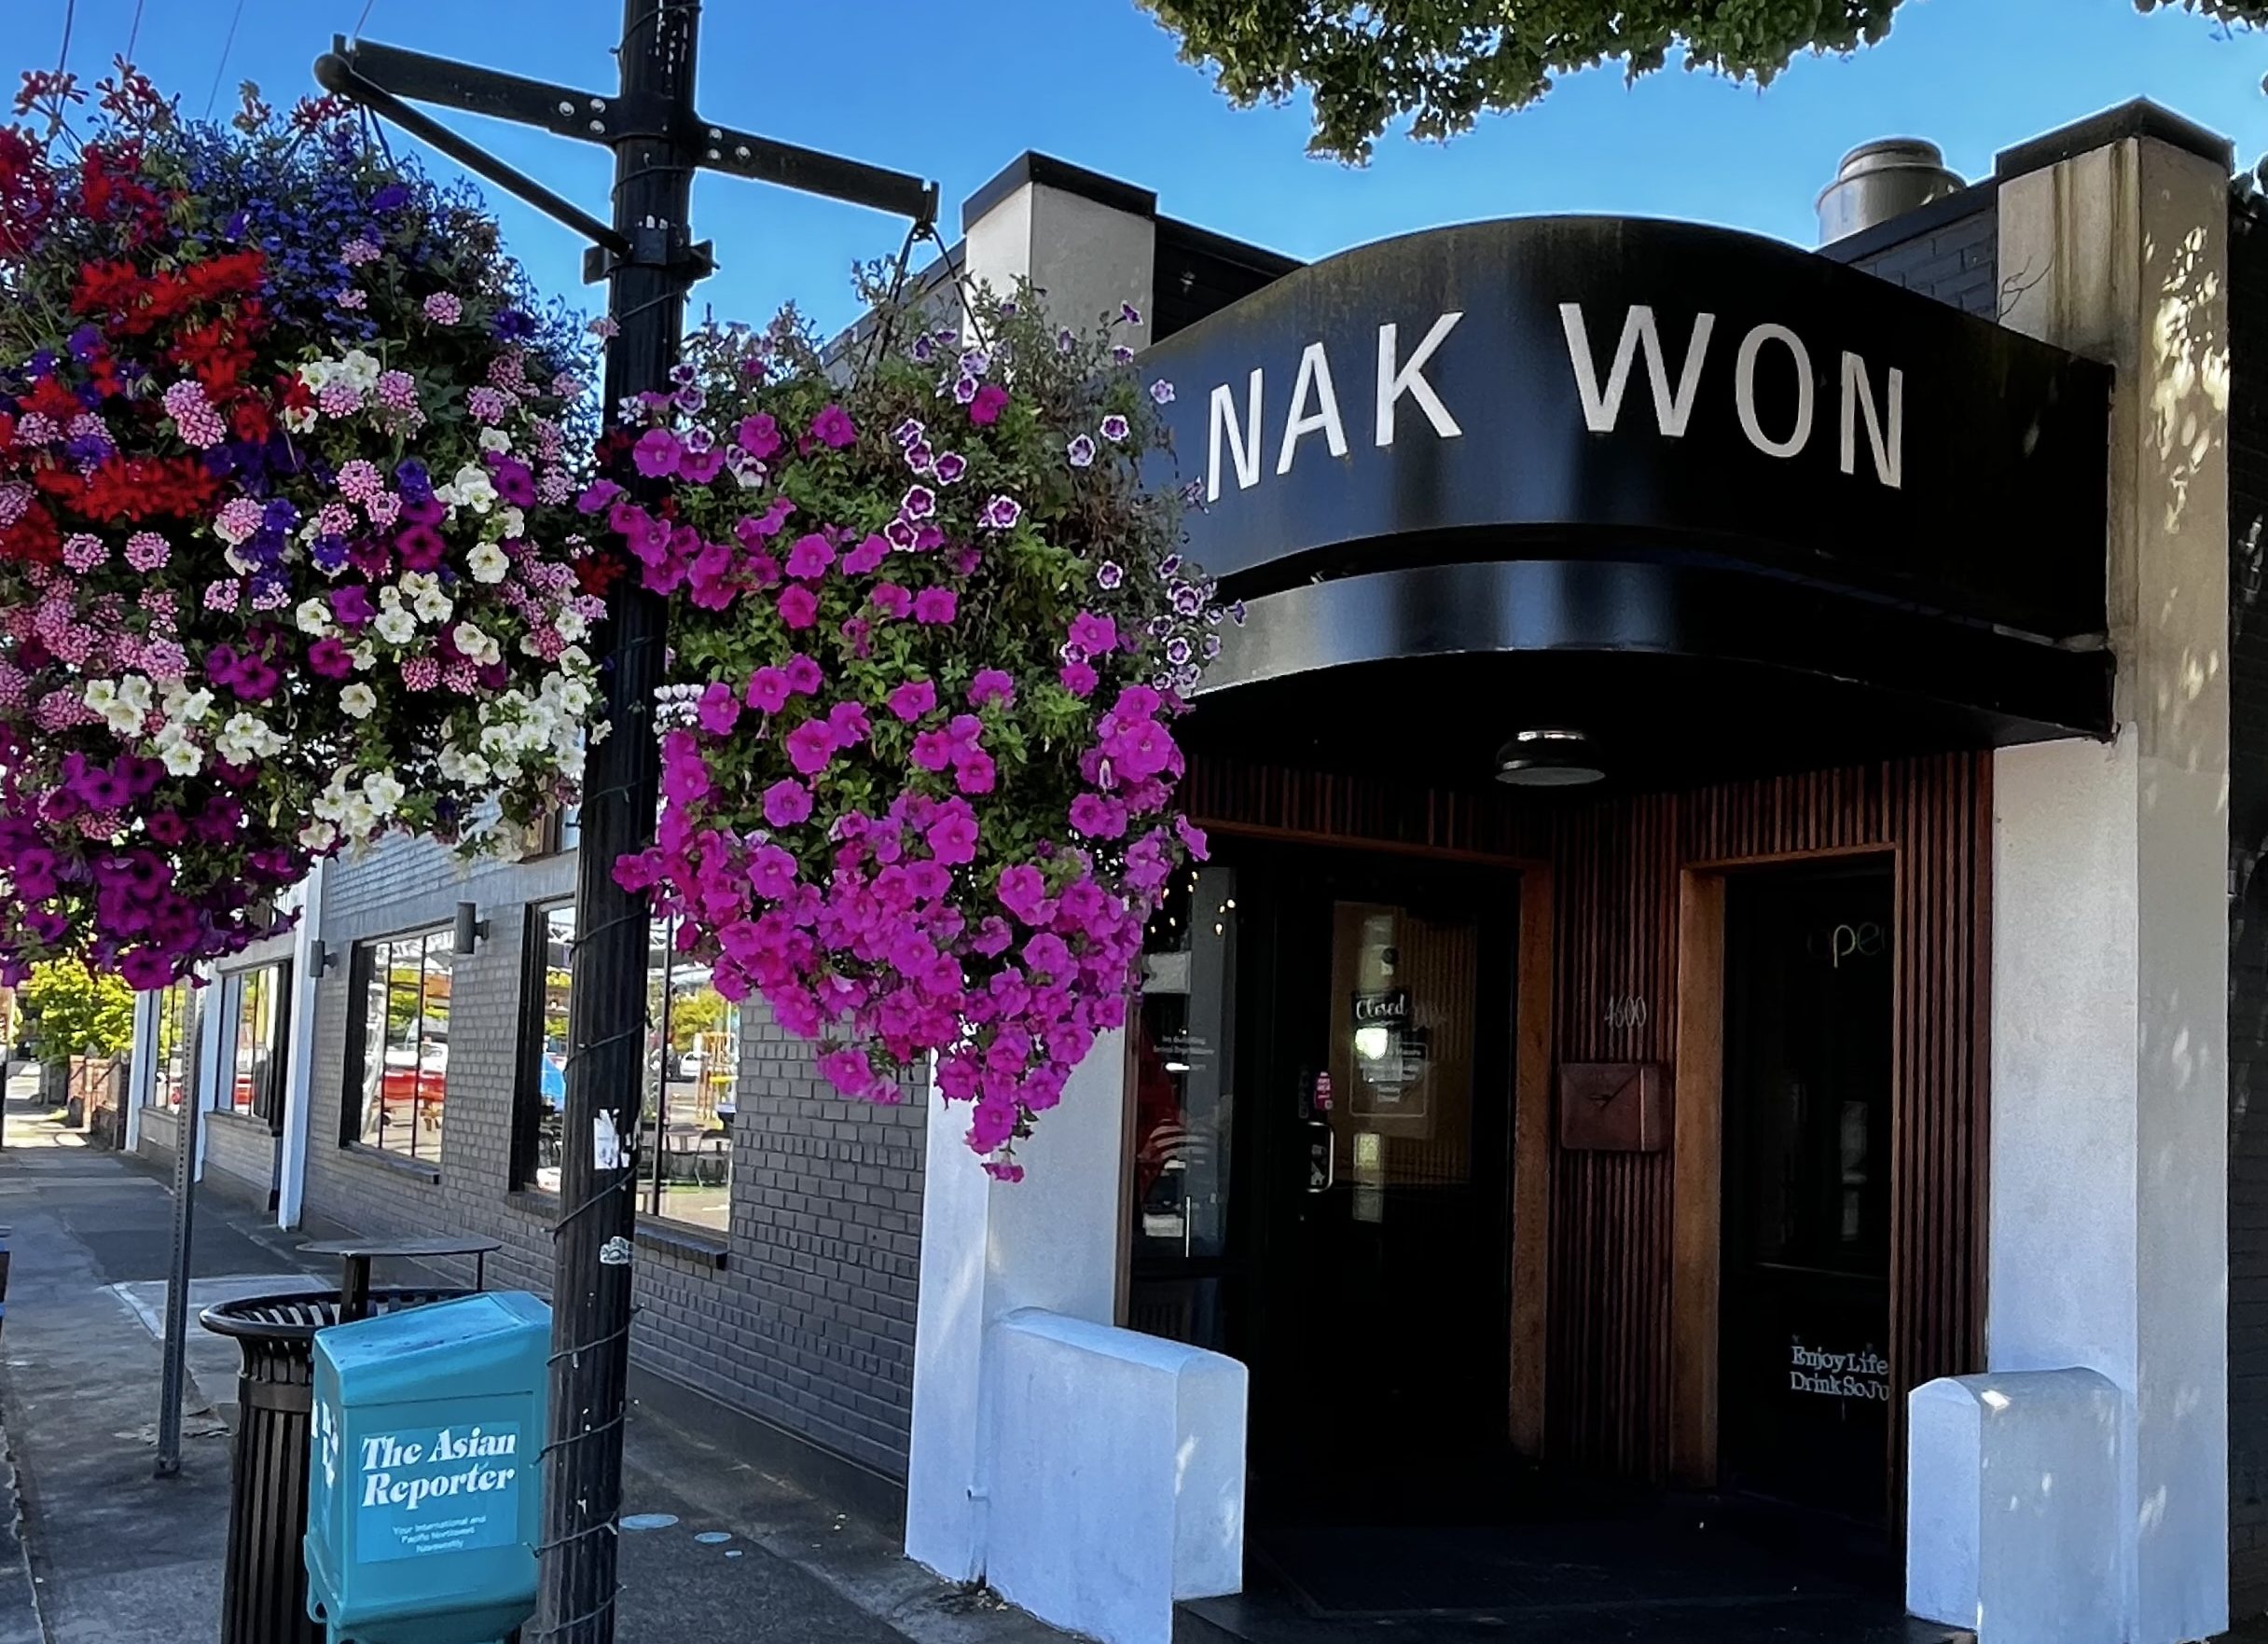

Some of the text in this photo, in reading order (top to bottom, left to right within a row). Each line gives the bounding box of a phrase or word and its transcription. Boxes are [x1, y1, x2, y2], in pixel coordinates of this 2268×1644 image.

[1207, 302, 1903, 502] NAK WON
[1355, 993, 1407, 1020] Closed
[1604, 994, 1648, 1029] 4600
[1791, 1346, 1888, 1375] Enjoy Life
[1790, 1371, 1843, 1395] Drink
[361, 1427, 517, 1471] The Asian
[361, 1464, 516, 1511] Reporter
